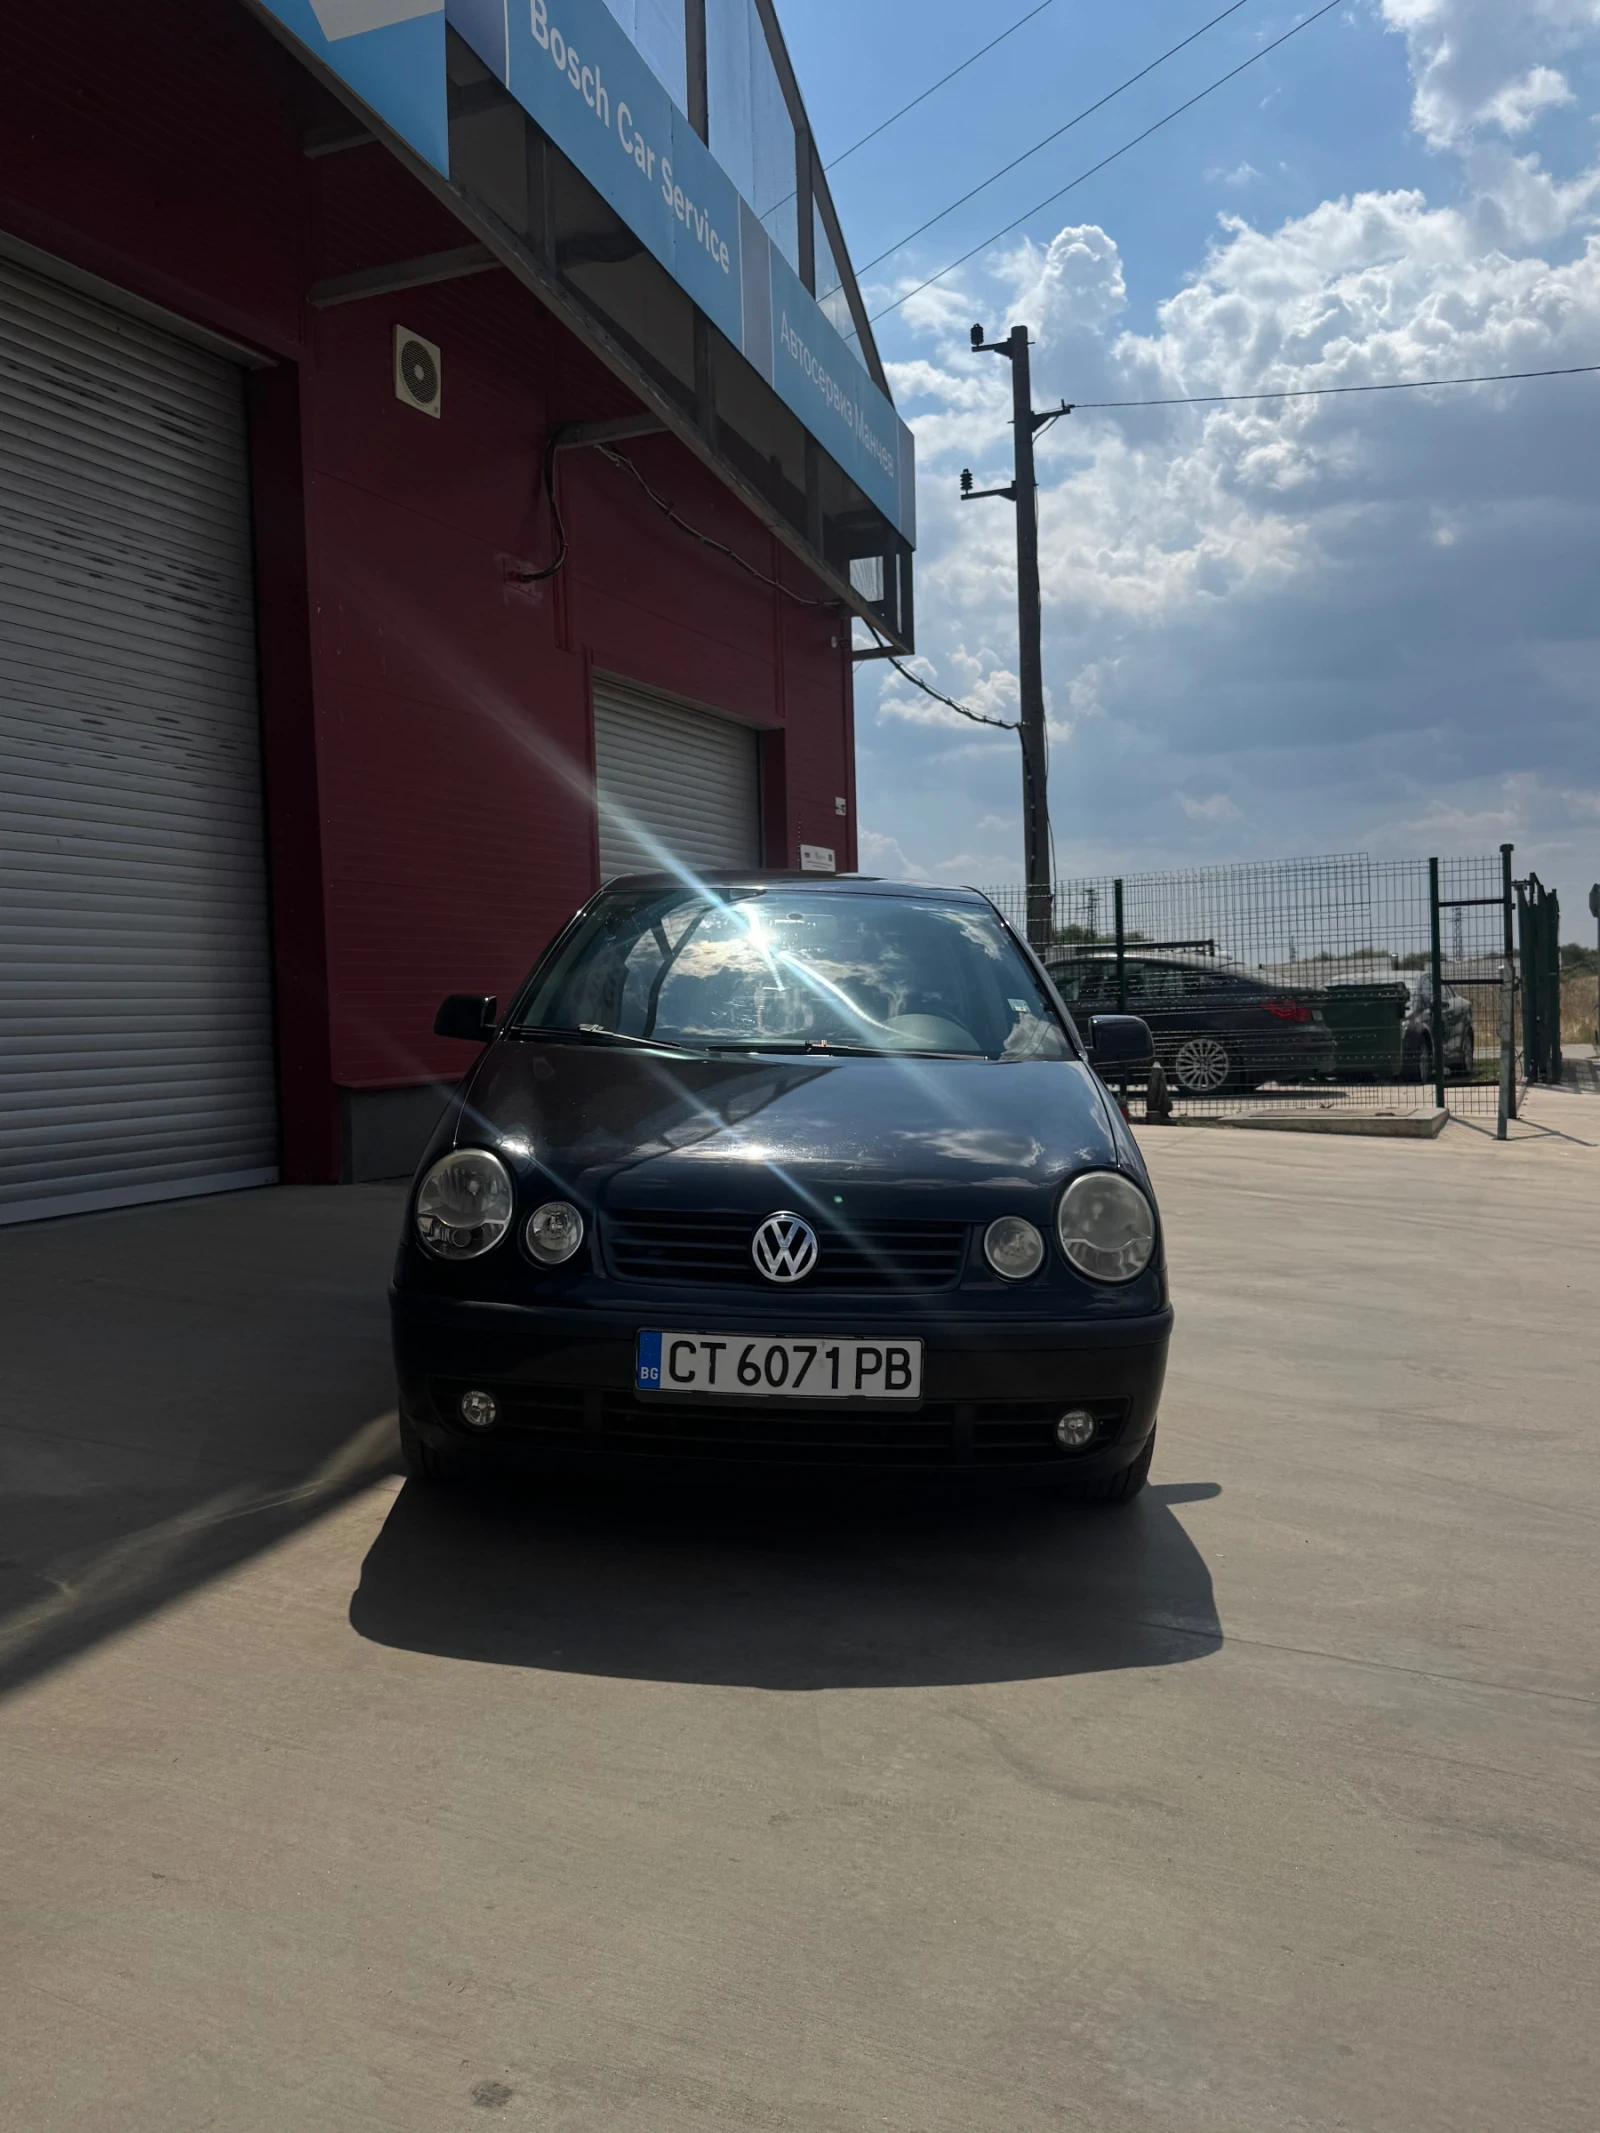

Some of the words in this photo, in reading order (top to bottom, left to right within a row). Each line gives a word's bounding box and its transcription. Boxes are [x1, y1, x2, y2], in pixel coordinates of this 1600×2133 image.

[530, 0, 610, 128] Bosch
[617, 101, 656, 181] Car
[661, 157, 730, 274] Service
[781, 310, 853, 427] Автосервиз
[855, 403, 894, 478] Манчев
[756, 1215, 815, 1279] VW
[641, 1366, 659, 1380] BG
[668, 1340, 727, 1384] CT
[737, 1344, 841, 1389] 6071
[855, 1347, 912, 1390] PB
